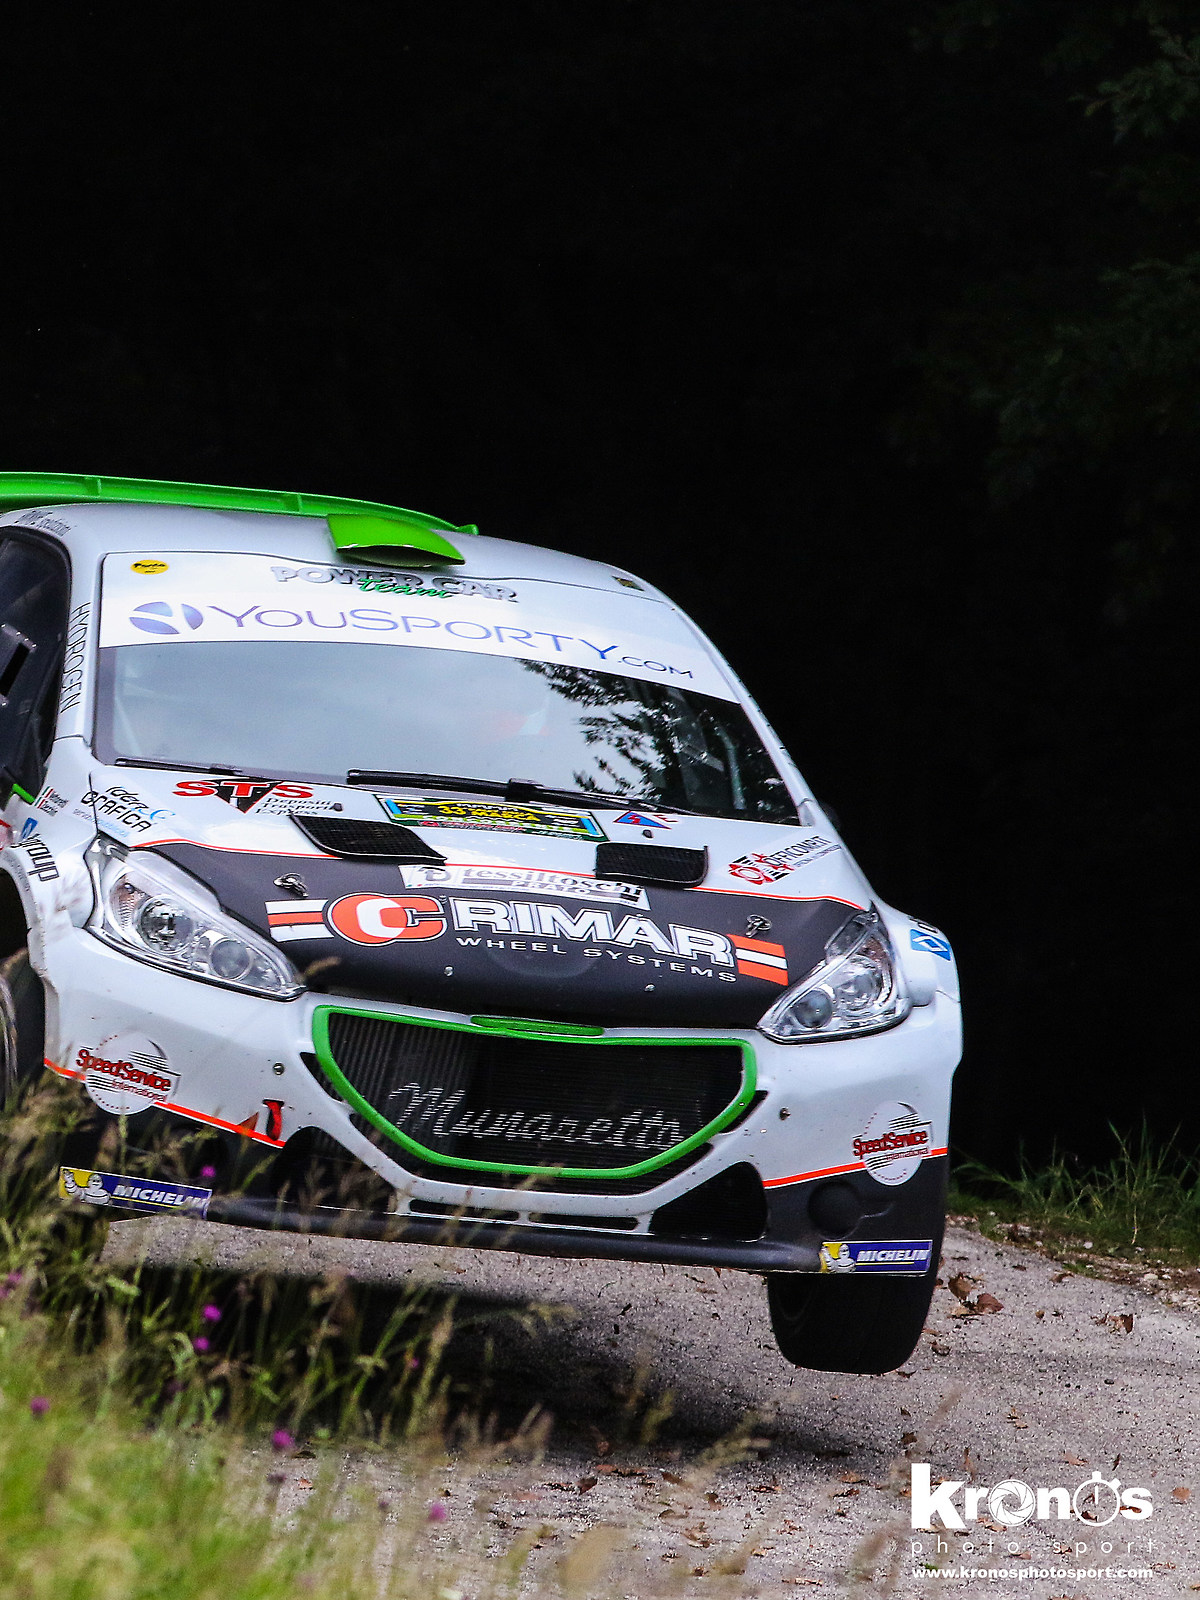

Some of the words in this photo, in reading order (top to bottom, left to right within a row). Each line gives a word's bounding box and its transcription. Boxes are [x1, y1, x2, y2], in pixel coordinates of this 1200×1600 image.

[431, 577, 519, 603] CAR
[60, 602, 91, 713] HYDROGEN
[172, 780, 314, 800] STS
[511, 881, 592, 895] PRATO
[326, 892, 737, 970] CRIMAR
[455, 937, 568, 955] WHEEL
[582, 947, 738, 983] SYSTEMS
[388, 1082, 685, 1150] Munaretto
[856, 1249, 931, 1263] MICHELIN
